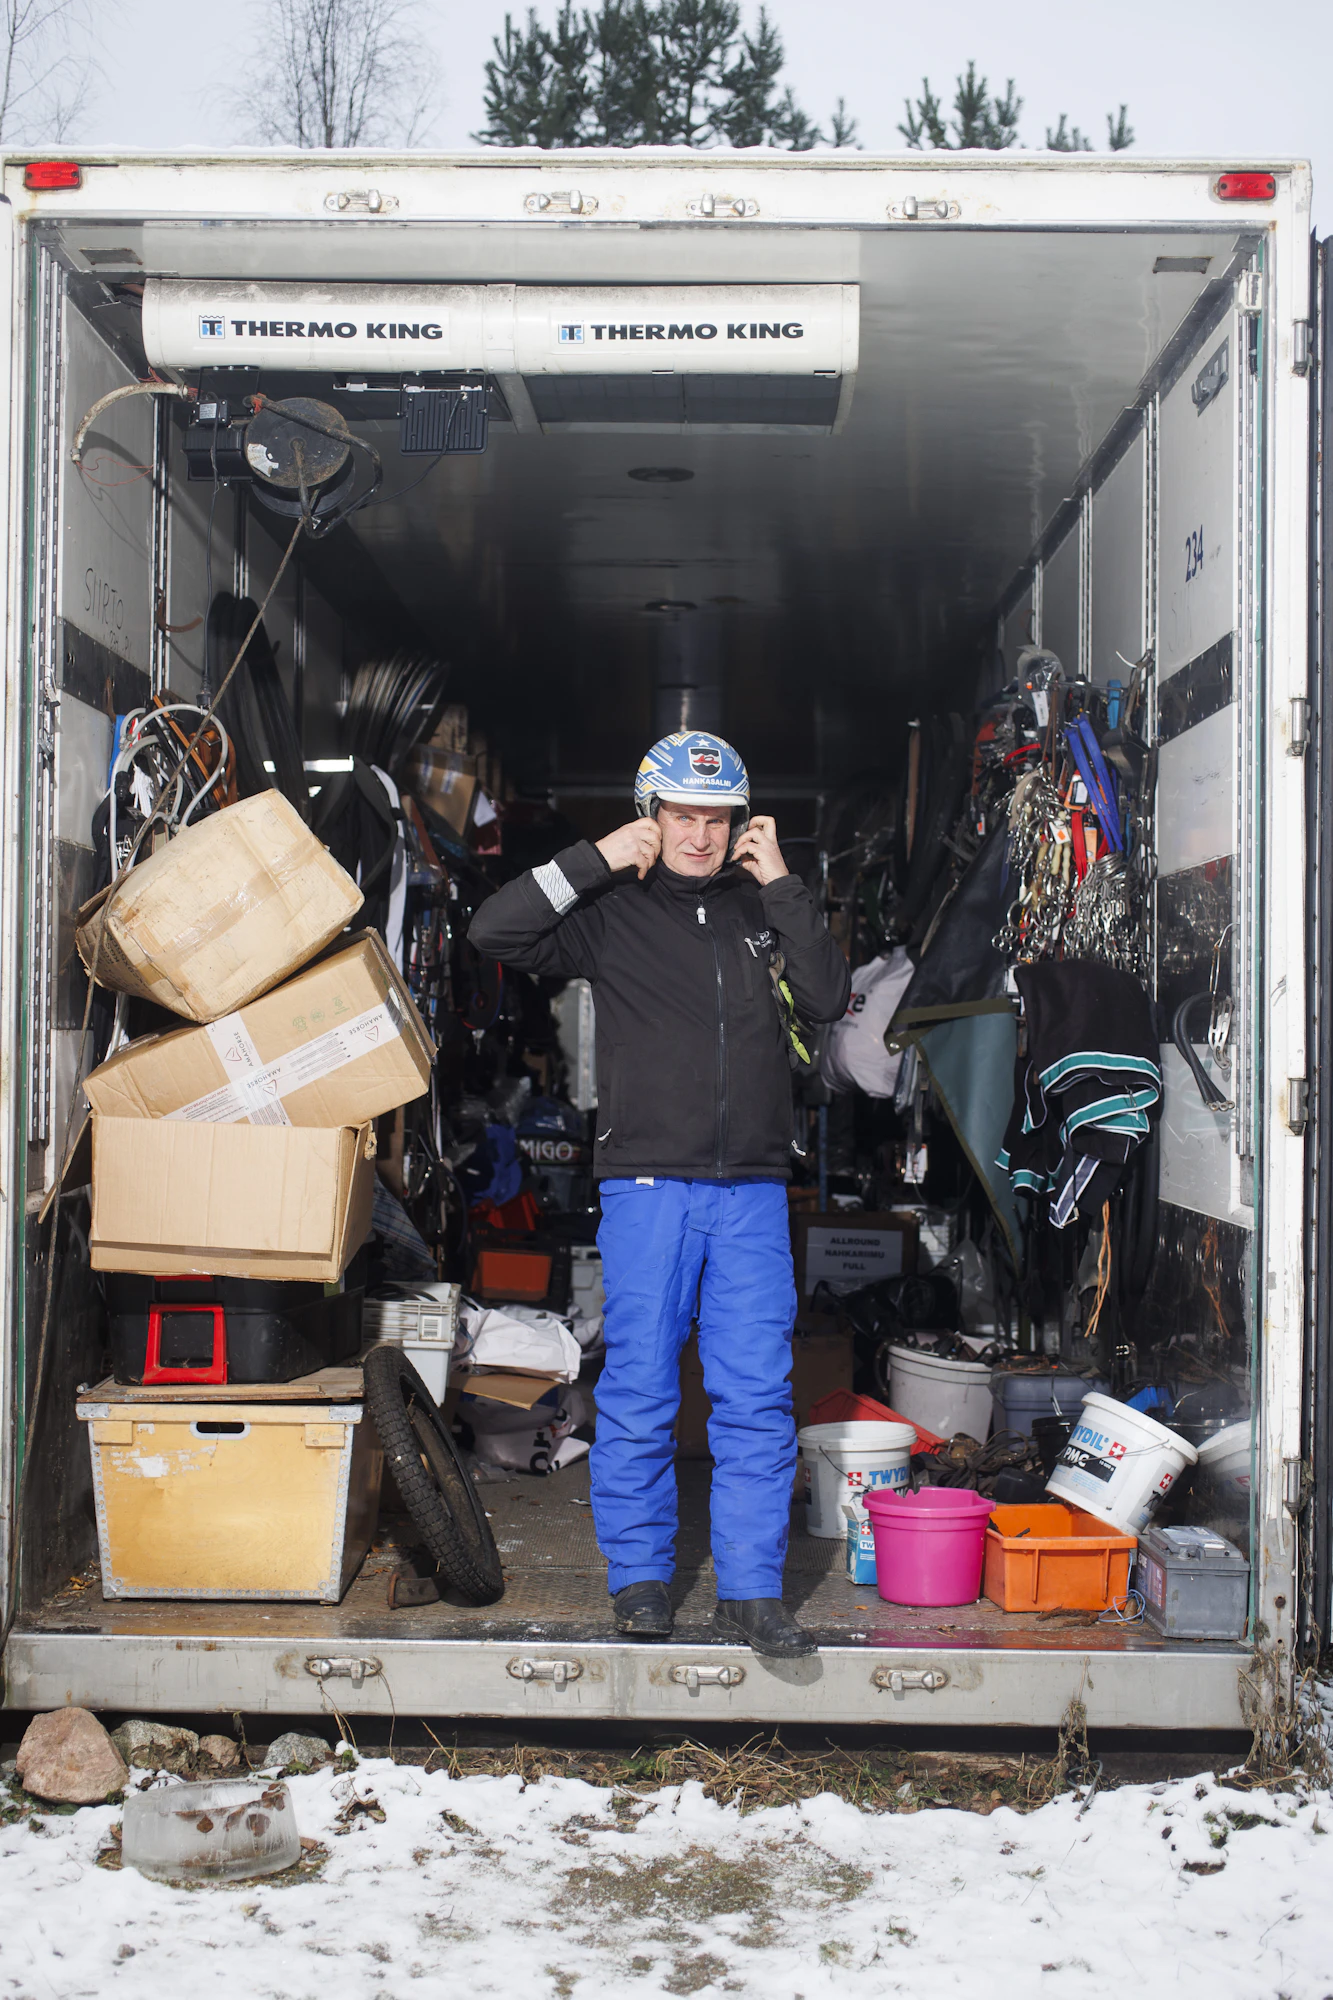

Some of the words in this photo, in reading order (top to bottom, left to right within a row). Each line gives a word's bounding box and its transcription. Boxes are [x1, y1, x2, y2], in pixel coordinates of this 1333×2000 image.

[231, 320, 357, 339] THERMO
[366, 322, 443, 341] KING
[590, 323, 718, 340] THERMO
[727, 322, 804, 340] KING
[1185, 523, 1204, 583] 234
[683, 777, 733, 788] HANKASALMI
[349, 1013, 383, 1036] AMAHORSE
[233, 1031, 254, 1067] AMAHORSE
[246, 1067, 281, 1089] AMAHORSE
[515, 1138, 573, 1160] MIGO
[829, 1236, 882, 1247] ALLROUND
[842, 1261, 867, 1271] FULL
[1063, 1446, 1090, 1468] PMC
[861, 1541, 875, 1549] TW
